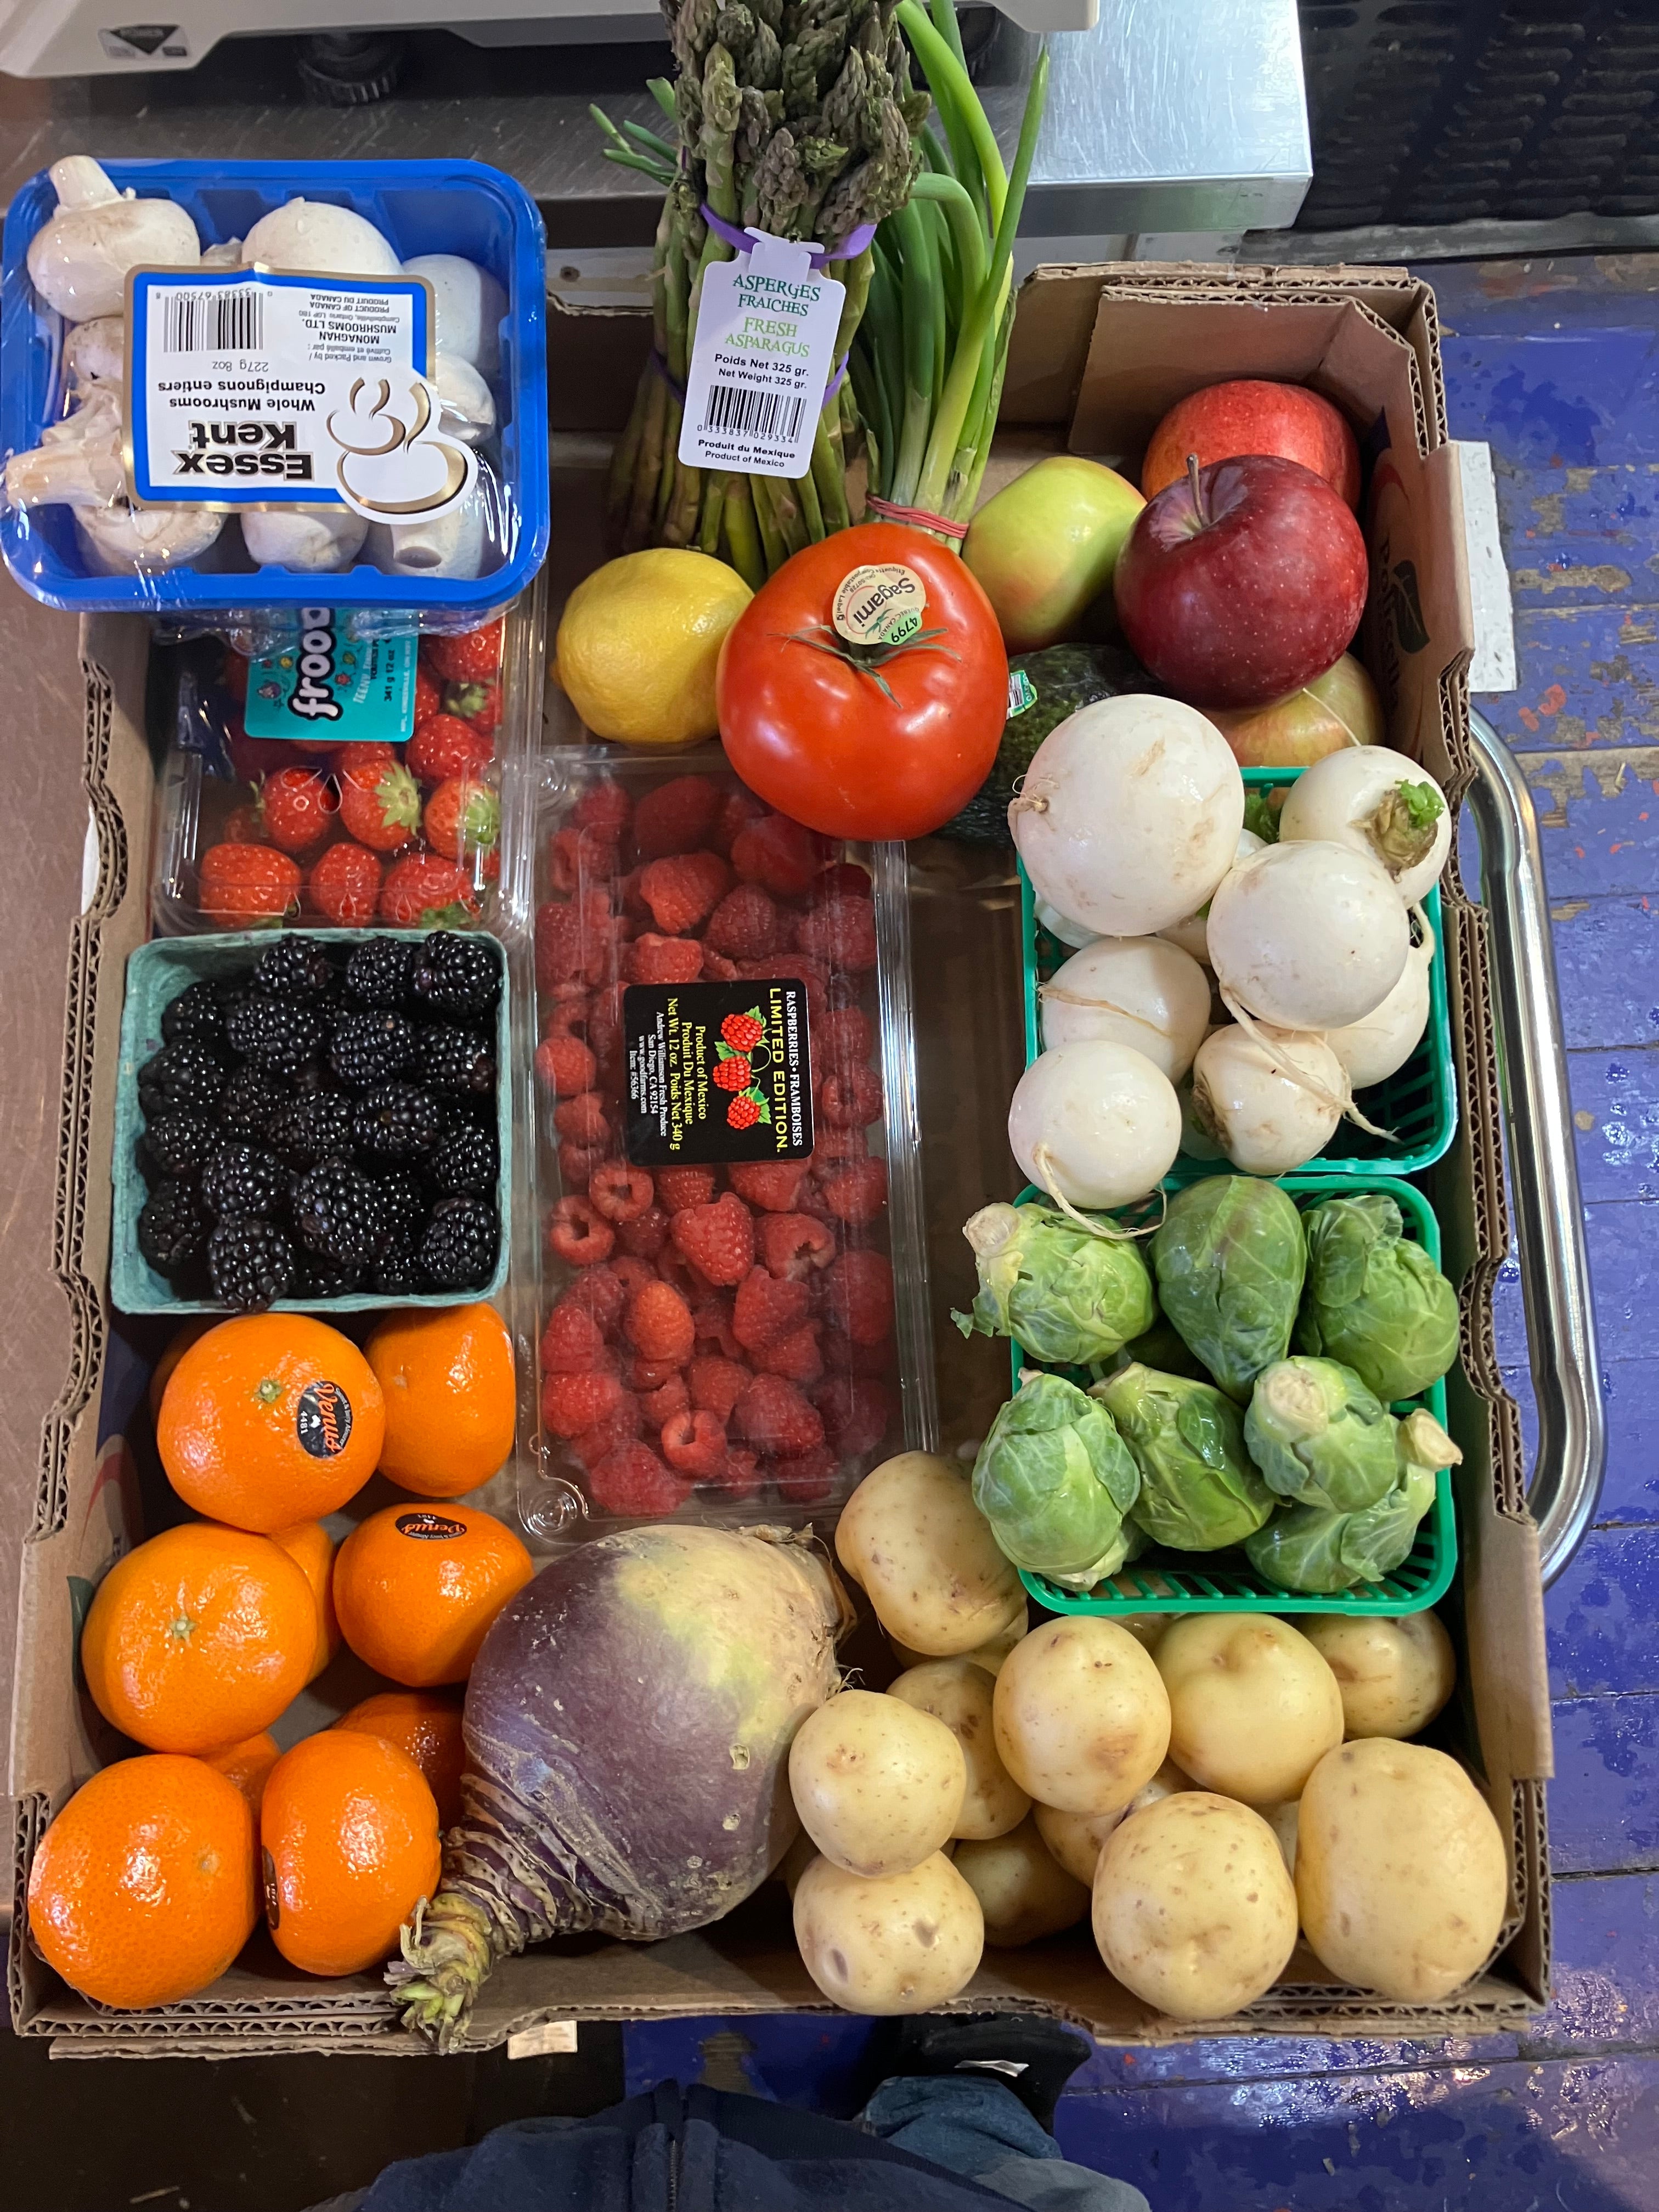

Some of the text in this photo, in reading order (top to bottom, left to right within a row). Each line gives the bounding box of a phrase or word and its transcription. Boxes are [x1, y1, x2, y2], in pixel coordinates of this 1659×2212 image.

[311, 294, 342, 303] CANADA
[733, 274, 821, 302] ASPERGES
[309, 302, 341, 310] CANADA
[738, 294, 809, 317] FRAICHES
[302, 319, 396, 334] MUSHROOMS LTD.
[742, 317, 798, 337] FRESH
[319, 331, 380, 344] MONAGHAN
[725, 334, 810, 357] ASPARAGUS
[212, 359, 269, 372] 227g 8oz
[325, 353, 351, 362] Packed
[715, 354, 809, 378] Poids Net 325 gr.
[158, 379, 325, 395] Champignons entiers
[719, 368, 807, 389] Net Weight 325 gr.
[170, 397, 315, 411] Whole Mushrooms
[189, 420, 297, 450] Kent
[698, 439, 795, 459] Produit du Mexique
[705, 450, 740, 462] Product
[754, 457, 785, 467] Mexico
[174, 451, 314, 481] Essex
[853, 578, 916, 627] Sagami
[878, 618, 896, 640] CANADA
[891, 617, 918, 642] 4799
[668, 998, 678, 1015] Net
[668, 1017, 679, 1036] Wt.
[770, 988, 784, 1063] LIMITED
[669, 1040, 680, 1051] 12
[647, 1034, 658, 1114] San Diego, CA 92154
[656, 1012, 668, 1137] Andrew Williamson Fresh Produce
[681, 1022, 695, 1125] Produit Du Mexique
[696, 1026, 709, 1120] Product of Mexico
[786, 991, 803, 1147] RASPBERRIES FRAMBOISES
[670, 1073, 681, 1100] Poids
[672, 1102, 682, 1121] Net
[672, 1122, 683, 1142] 340
[314, 1384, 344, 1453] Venus
[401, 1523, 465, 1534] Venus
